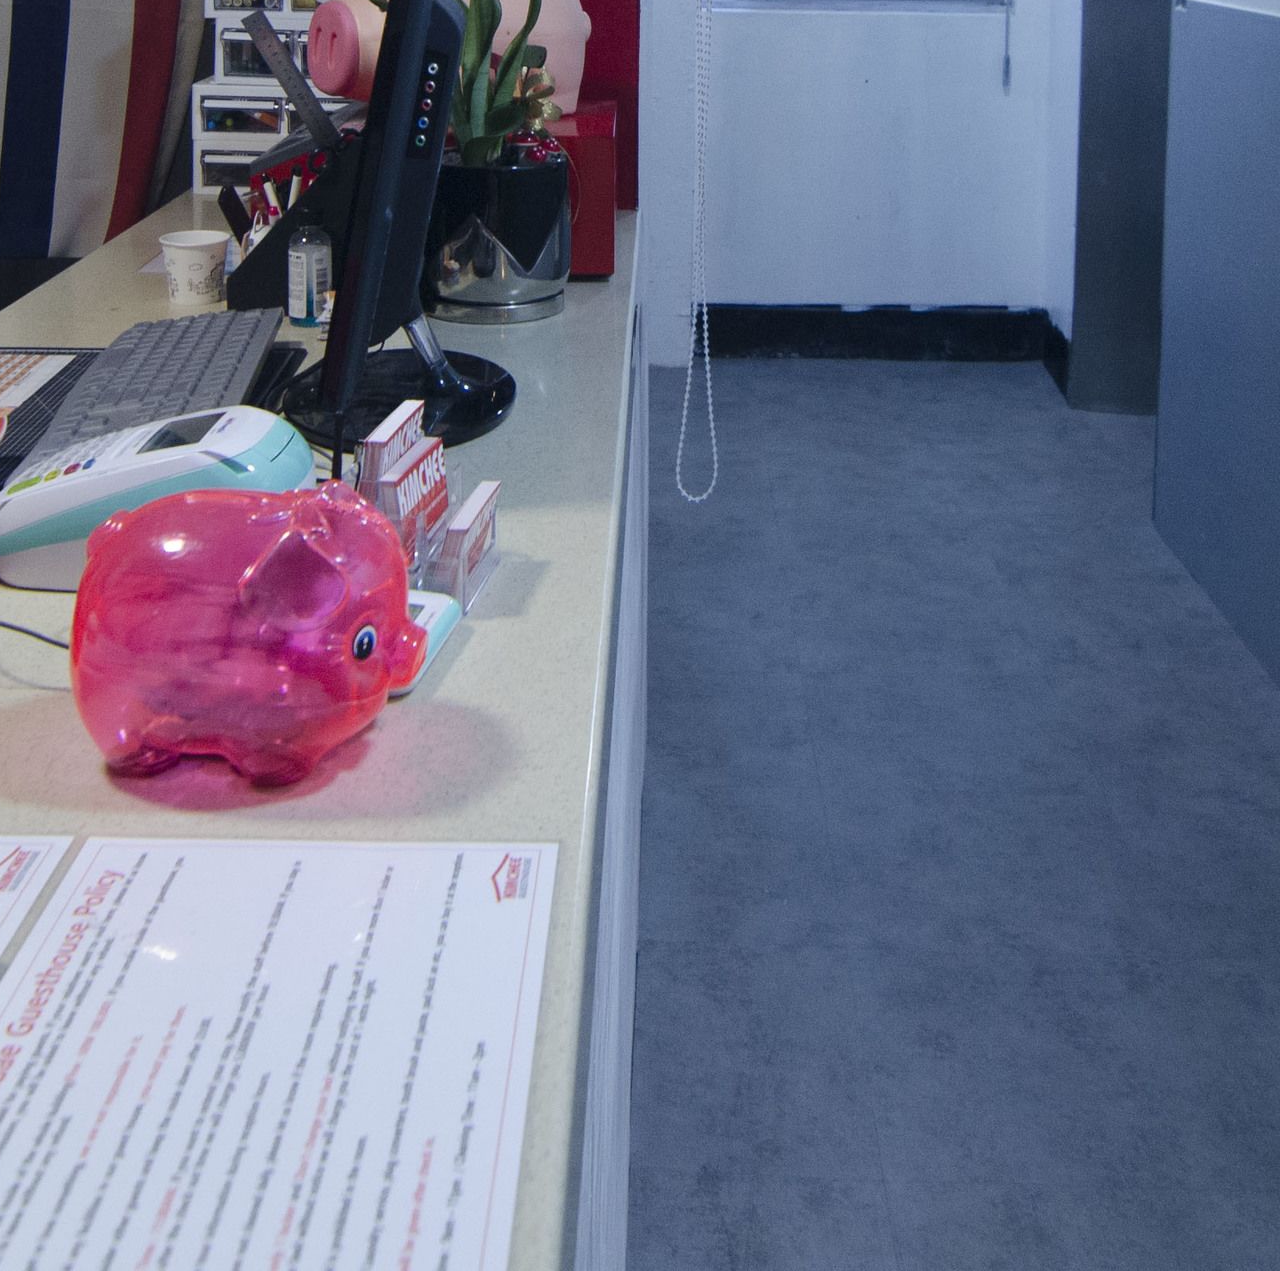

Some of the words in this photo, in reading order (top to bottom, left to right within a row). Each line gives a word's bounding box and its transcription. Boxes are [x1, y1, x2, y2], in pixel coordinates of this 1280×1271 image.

[397, 443, 447, 518] KIMCHEE
[6, 922, 91, 1037] Guesthouse
[74, 869, 125, 917] Policy
